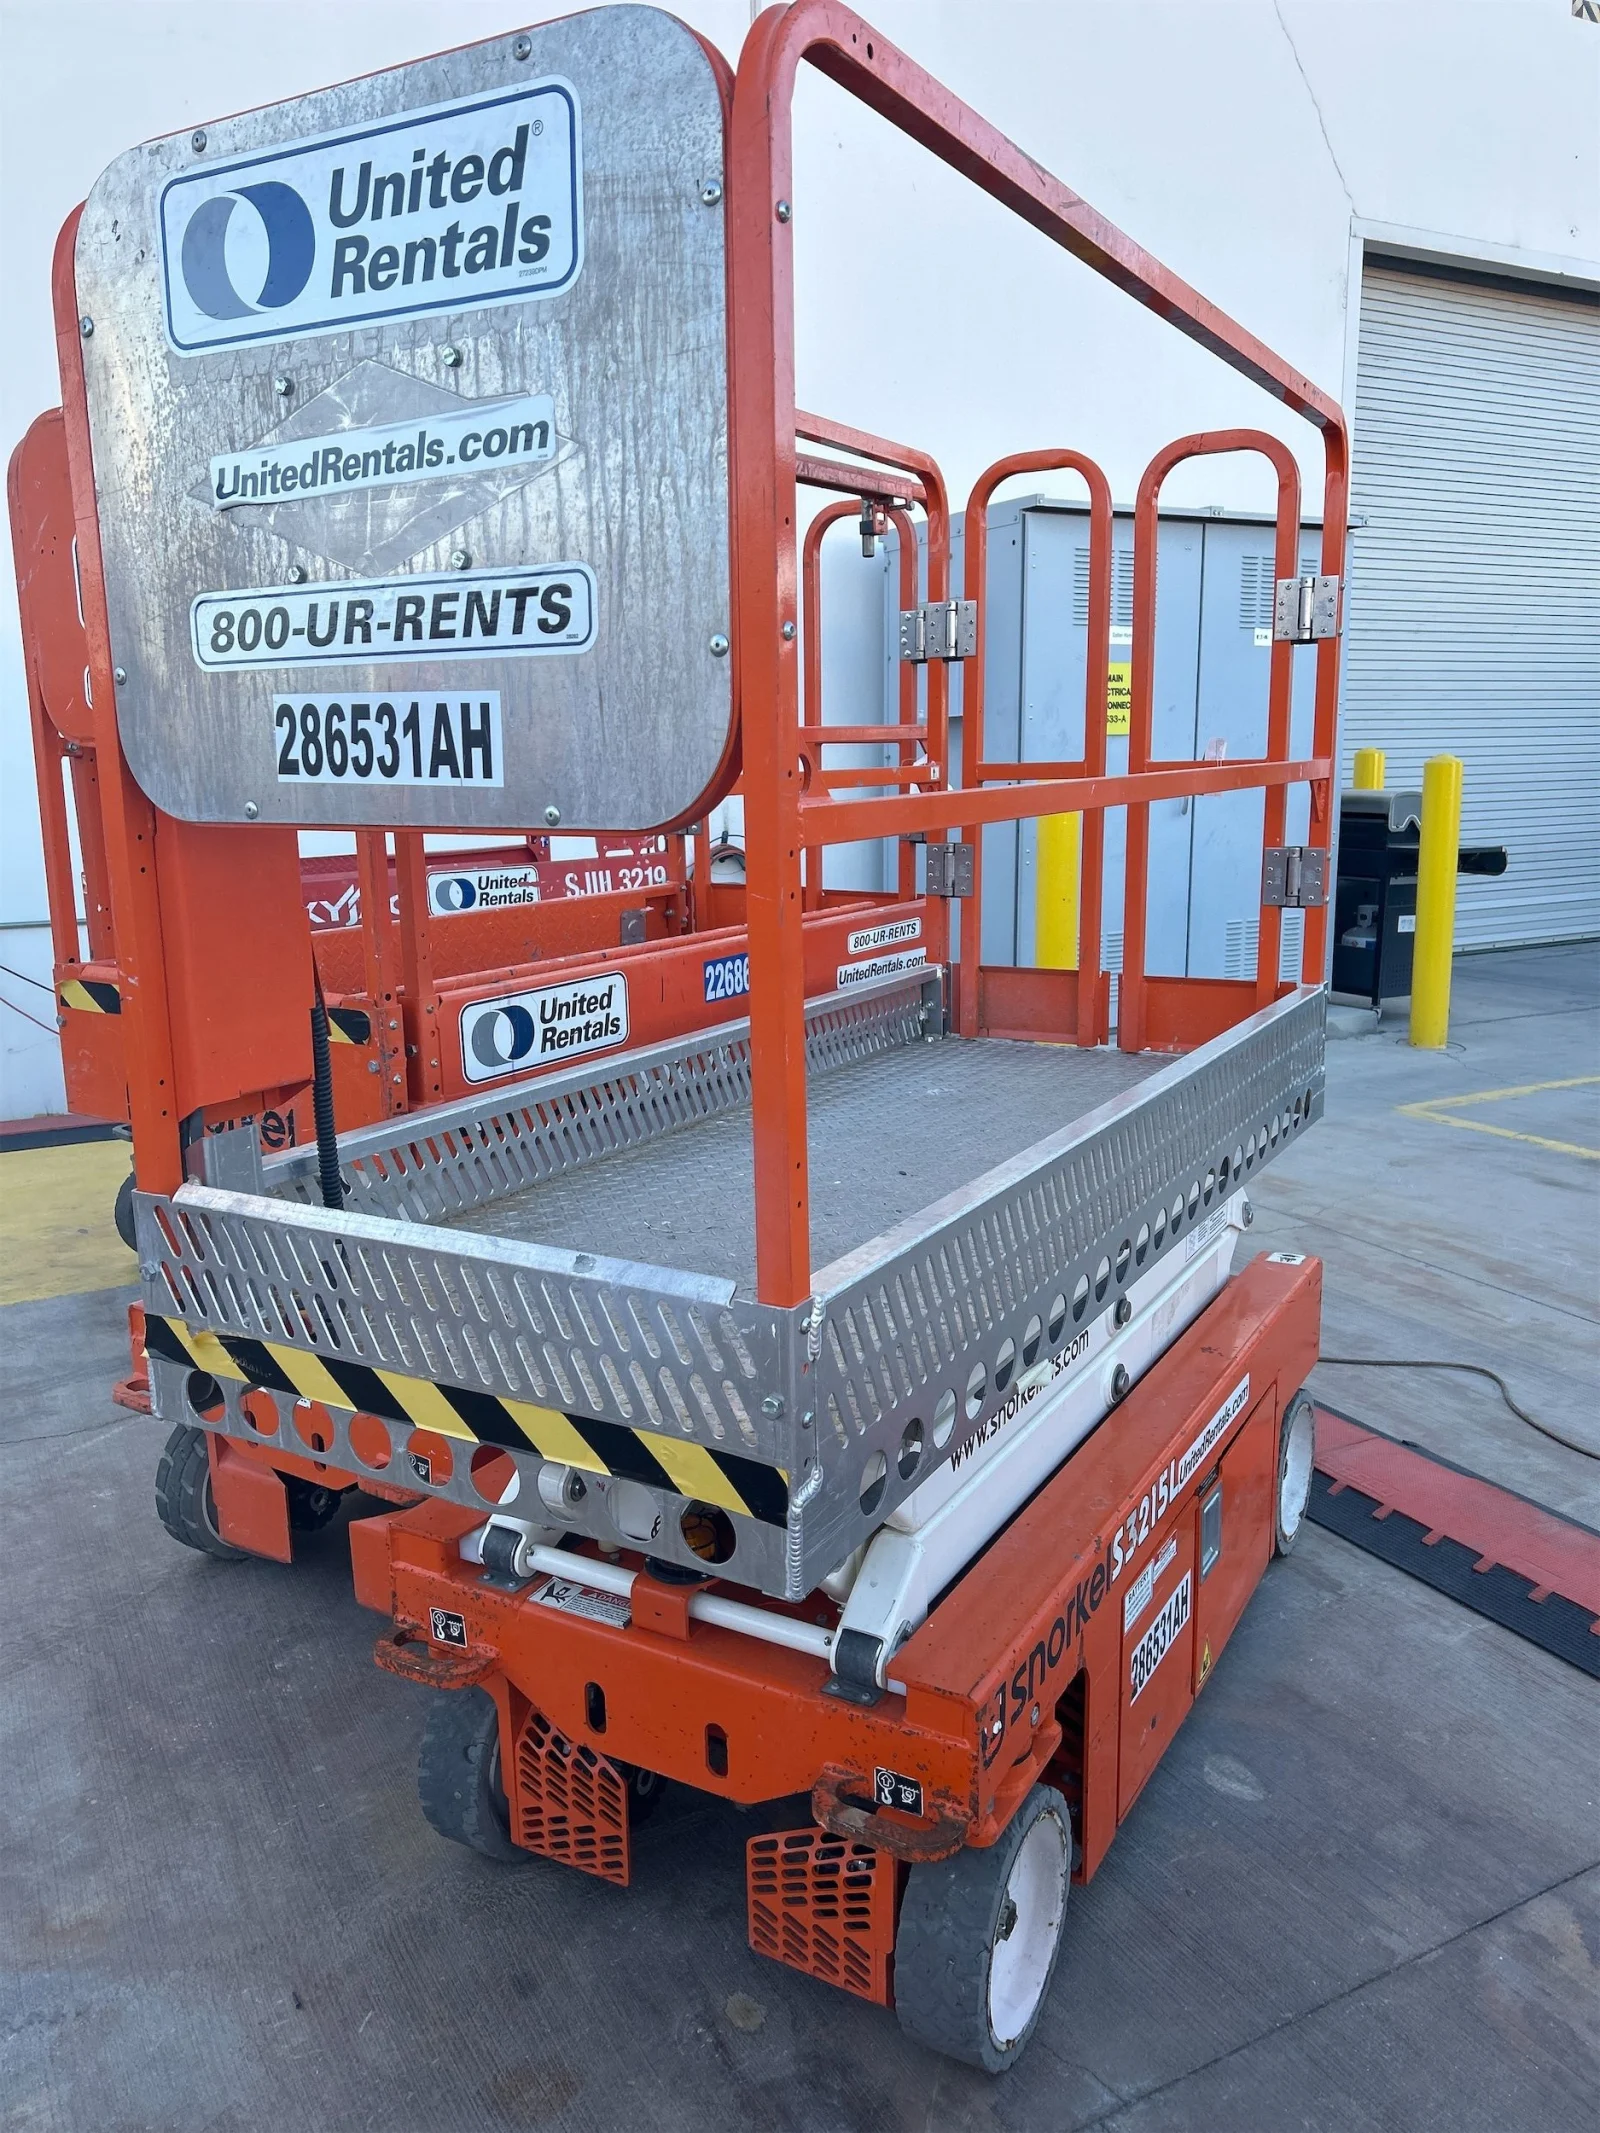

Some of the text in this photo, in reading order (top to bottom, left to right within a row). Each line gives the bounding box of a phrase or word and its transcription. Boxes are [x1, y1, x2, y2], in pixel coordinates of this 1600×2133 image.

[330, 201, 552, 298] Rentals
[216, 419, 550, 500] UnitedRentals.com
[210, 583, 573, 653] 800-UR-RENTS
[275, 701, 493, 779] 286531AH
[478, 873, 527, 891] United
[479, 888, 534, 906] Rentals
[618, 865, 667, 890] 3219
[853, 922, 917, 949] 800-UR-RENTS
[838, 955, 927, 985] UnitedRentals.com
[540, 984, 613, 1025] United
[540, 1012, 621, 1054] Rentals
[1011, 1458, 1180, 1727] snorkel S3215L
